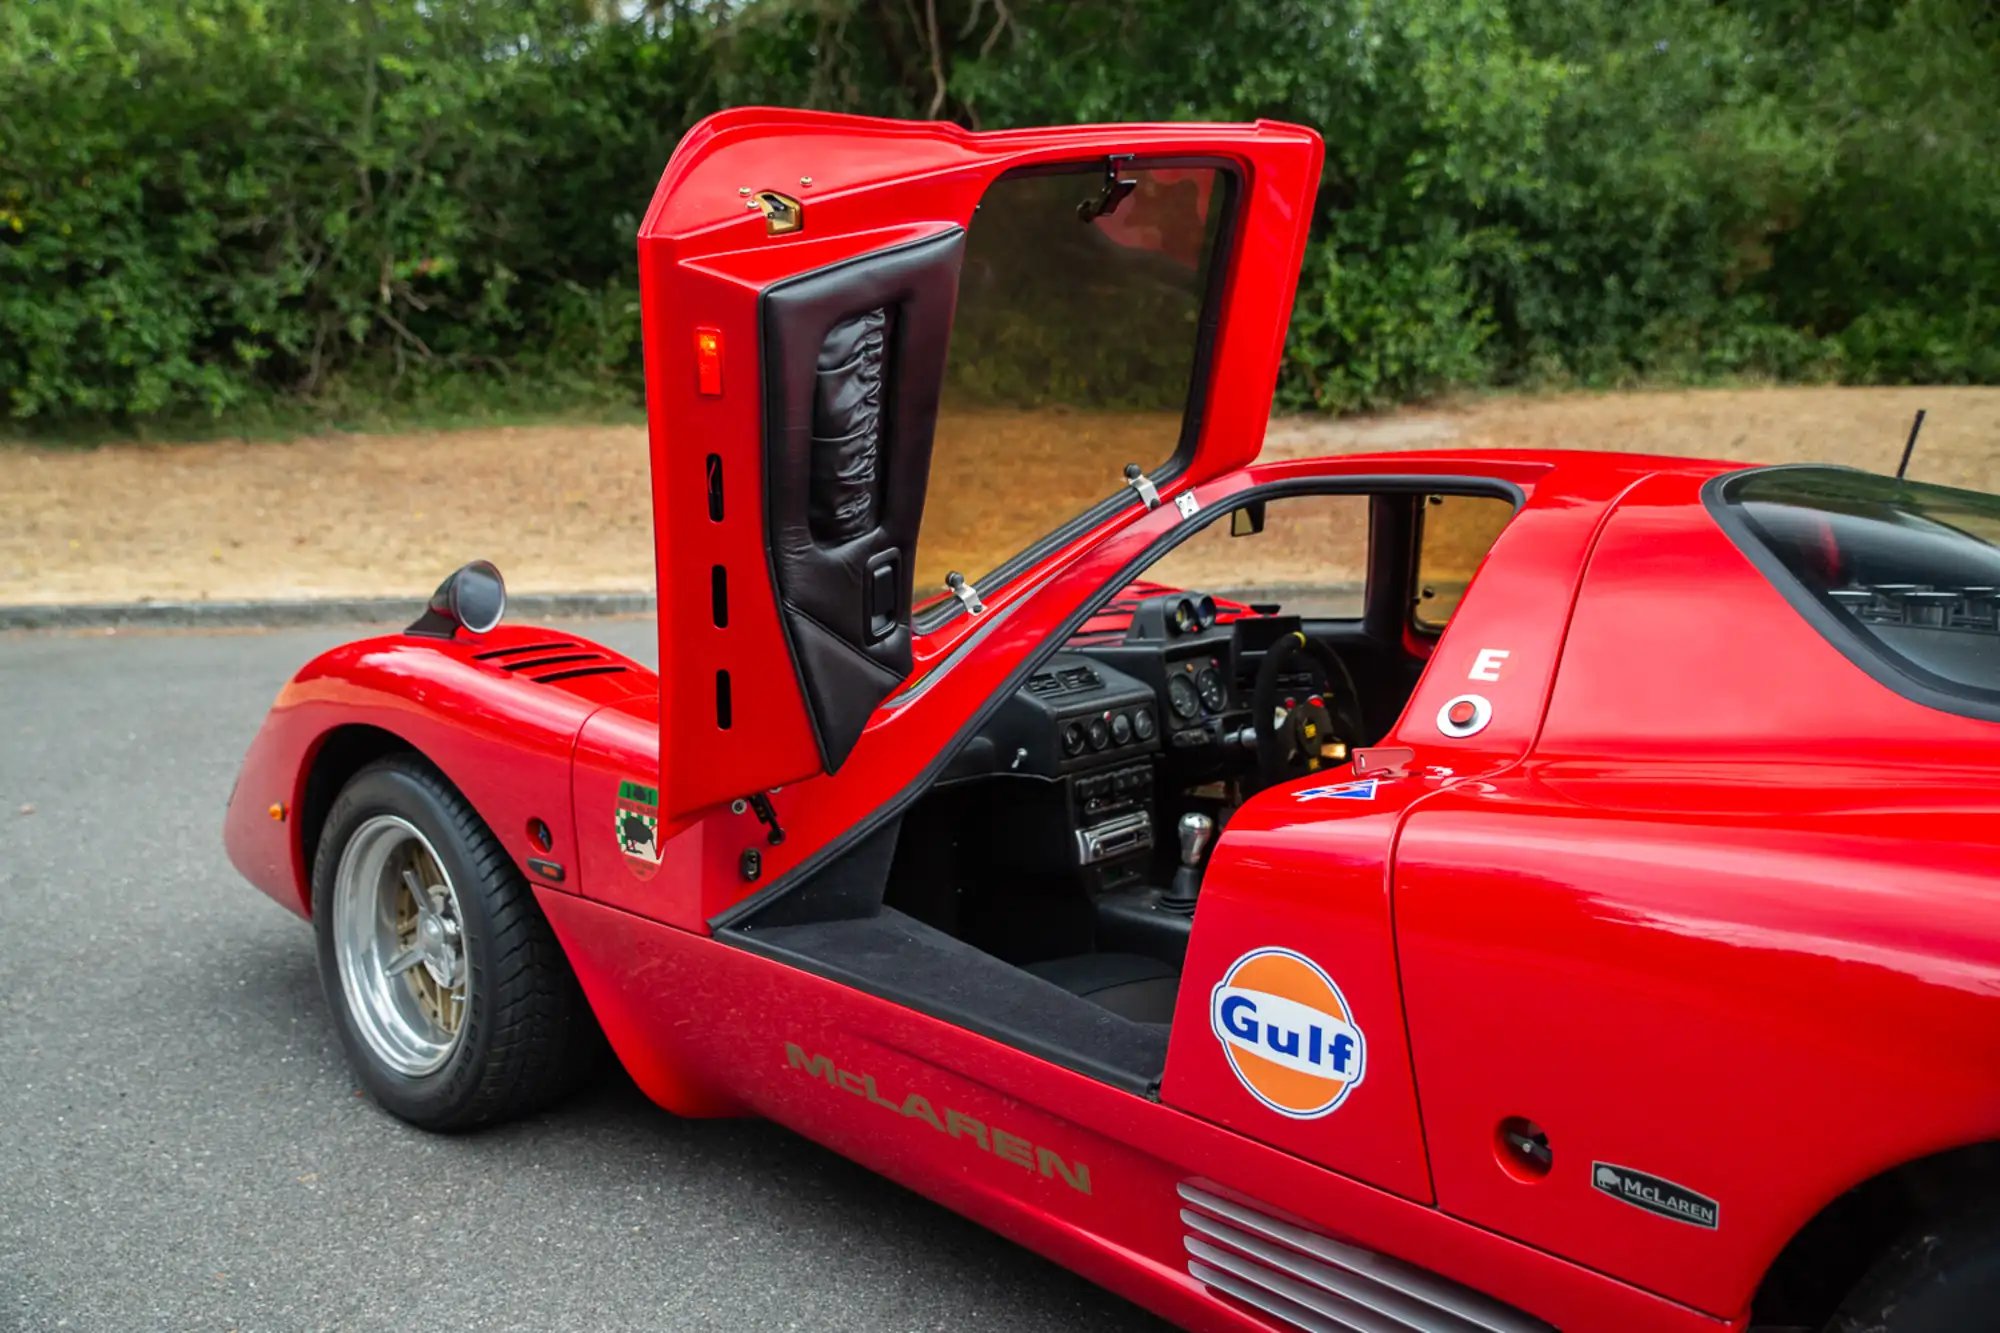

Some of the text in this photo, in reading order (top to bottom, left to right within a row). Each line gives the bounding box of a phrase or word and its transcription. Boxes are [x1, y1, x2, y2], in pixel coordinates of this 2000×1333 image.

[1468, 648, 1510, 681] E
[1221, 995, 1354, 1073] Gulf
[1624, 1177, 1713, 1220] McLAREN
